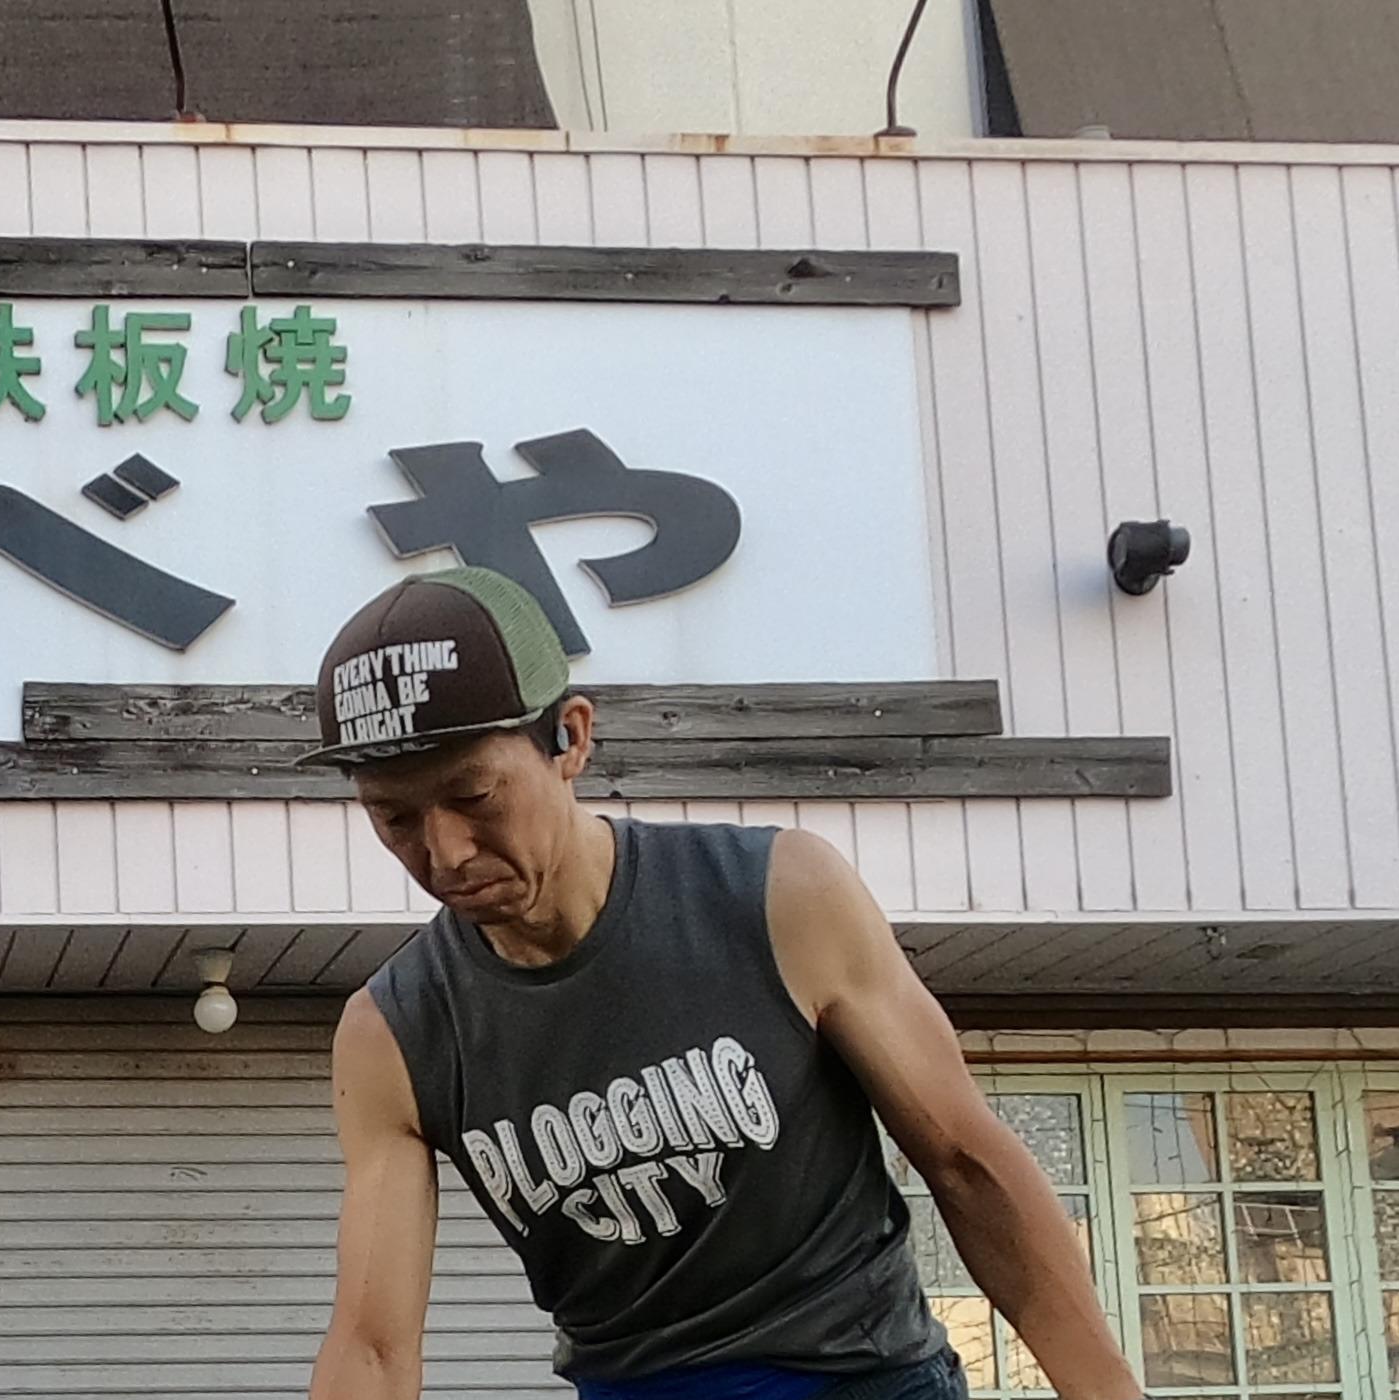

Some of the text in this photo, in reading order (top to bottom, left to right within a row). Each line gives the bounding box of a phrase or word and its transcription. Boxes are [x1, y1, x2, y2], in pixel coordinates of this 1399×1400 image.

[333, 639, 459, 694] EVERYTHING
[335, 671, 431, 723] GONNA BE
[340, 704, 417, 745] ALRIGHT
[461, 1036, 780, 1238] PLOGGING
[561, 1152, 727, 1246] CITY
